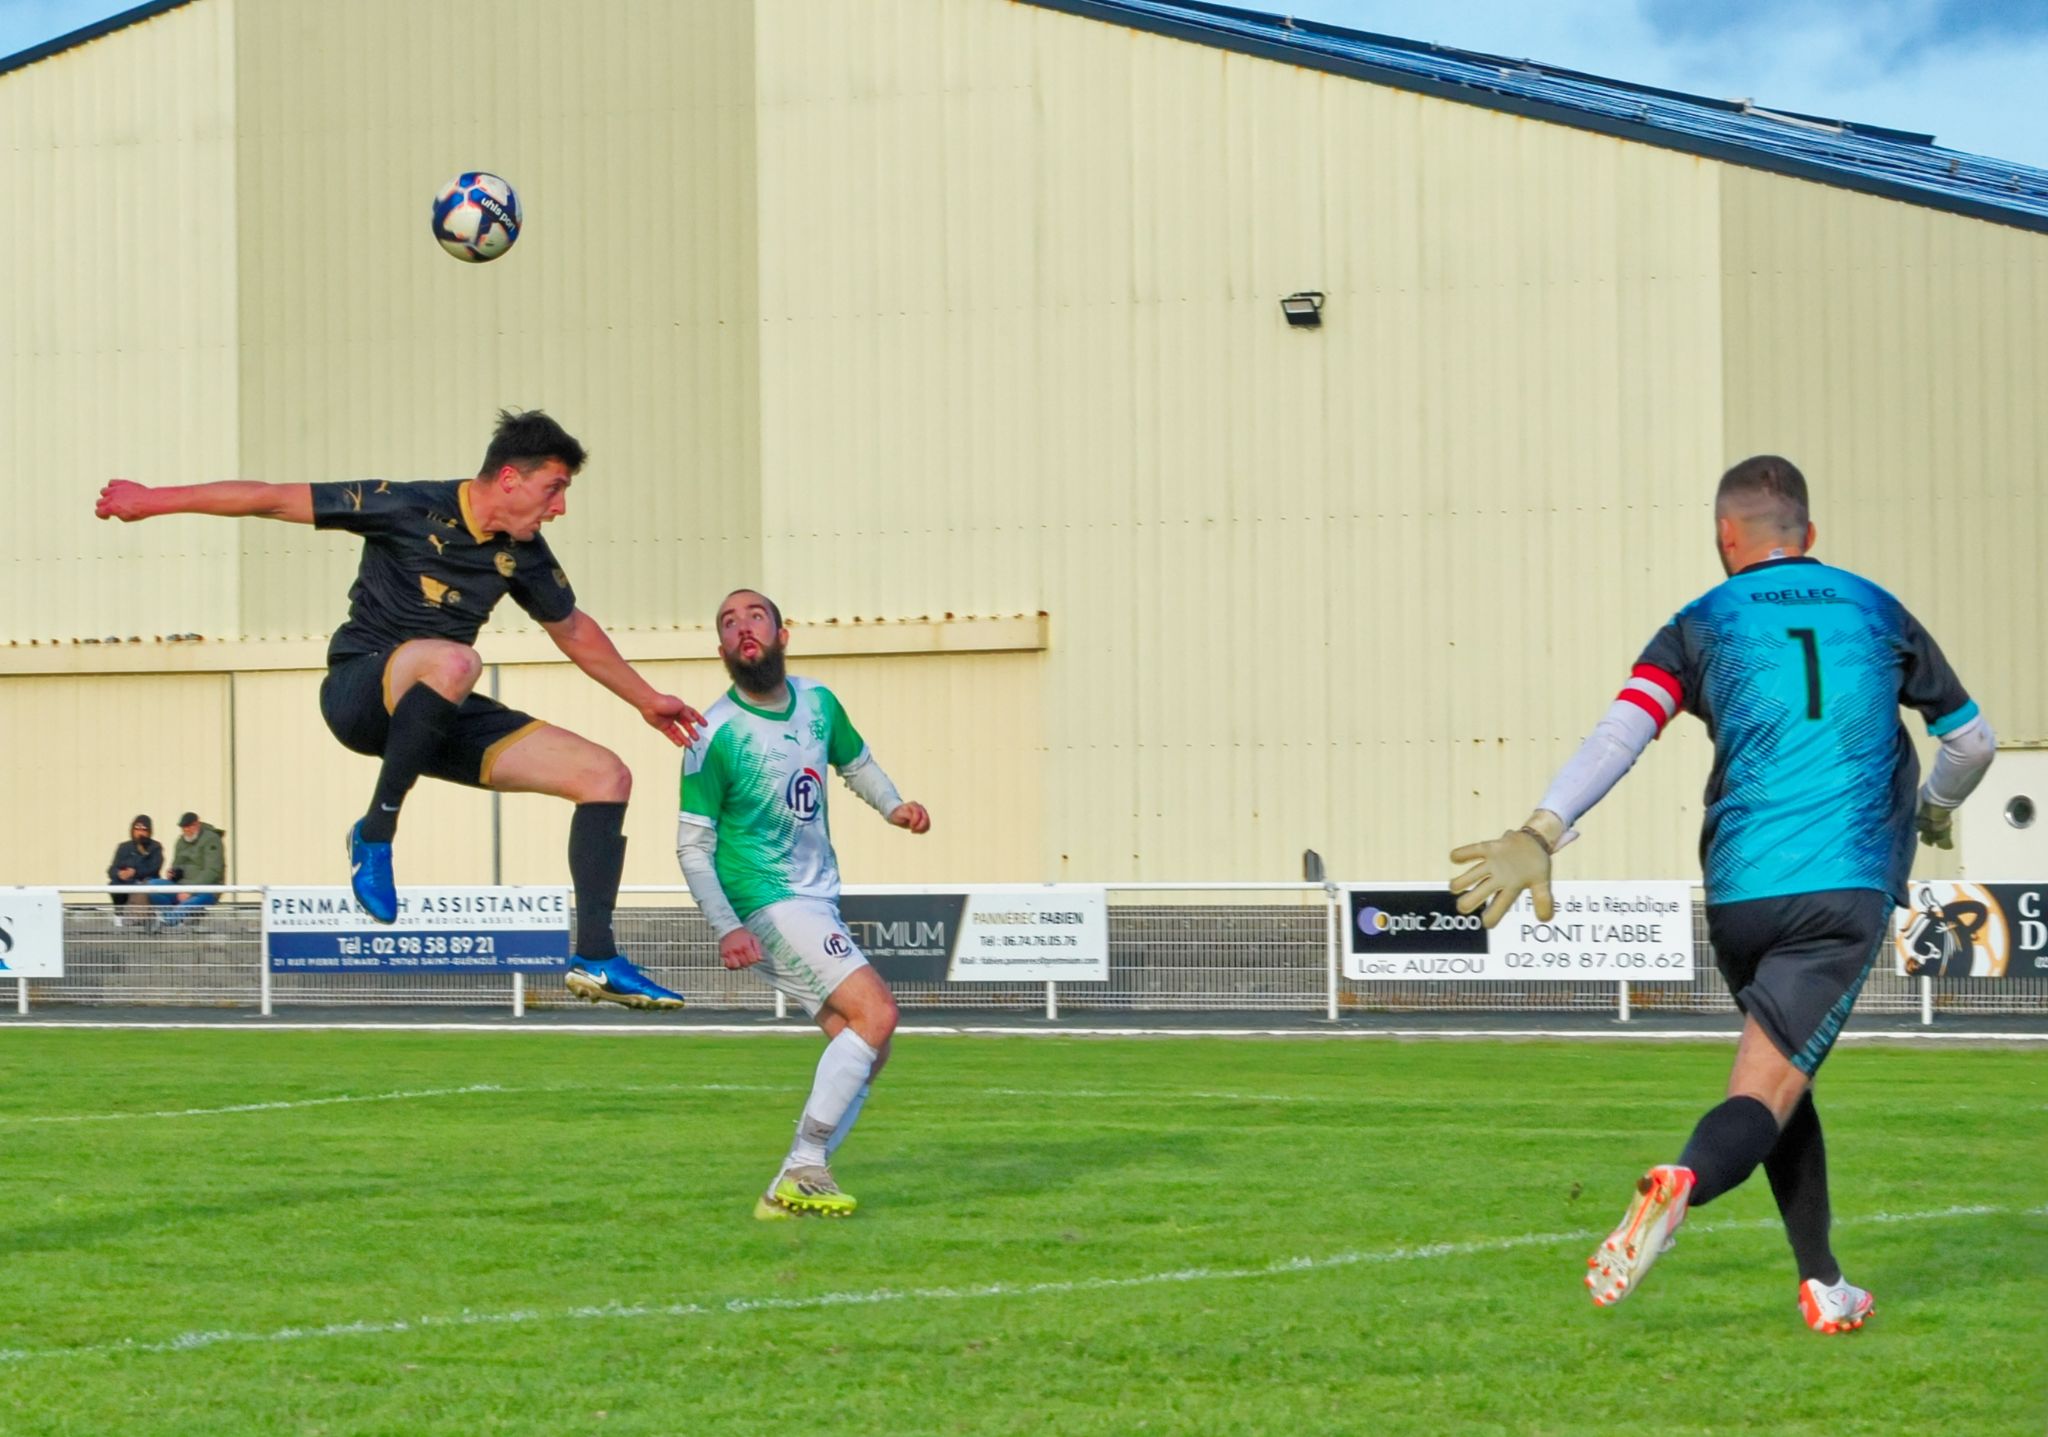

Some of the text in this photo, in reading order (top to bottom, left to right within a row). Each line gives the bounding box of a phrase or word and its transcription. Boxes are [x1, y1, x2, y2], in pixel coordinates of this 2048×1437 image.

[1750, 588, 1837, 602] EDELEC
[1787, 628, 1821, 720] 1
[421, 896, 564, 913] ASSISTANCE
[1564, 895, 1583, 912] de
[1587, 895, 1600, 912] la
[1604, 895, 1680, 918] République
[1039, 911, 1083, 925] FABIEN
[1520, 923, 1663, 943] PONT L'ABBE
[372, 936, 396, 955] 02
[397, 936, 422, 955] 98
[424, 936, 447, 954] 58
[450, 936, 473, 954] 89
[475, 936, 495, 954] 21
[1358, 958, 1485, 975] Loïc AUZOU
[1578, 952, 1686, 968] 87.08.62
